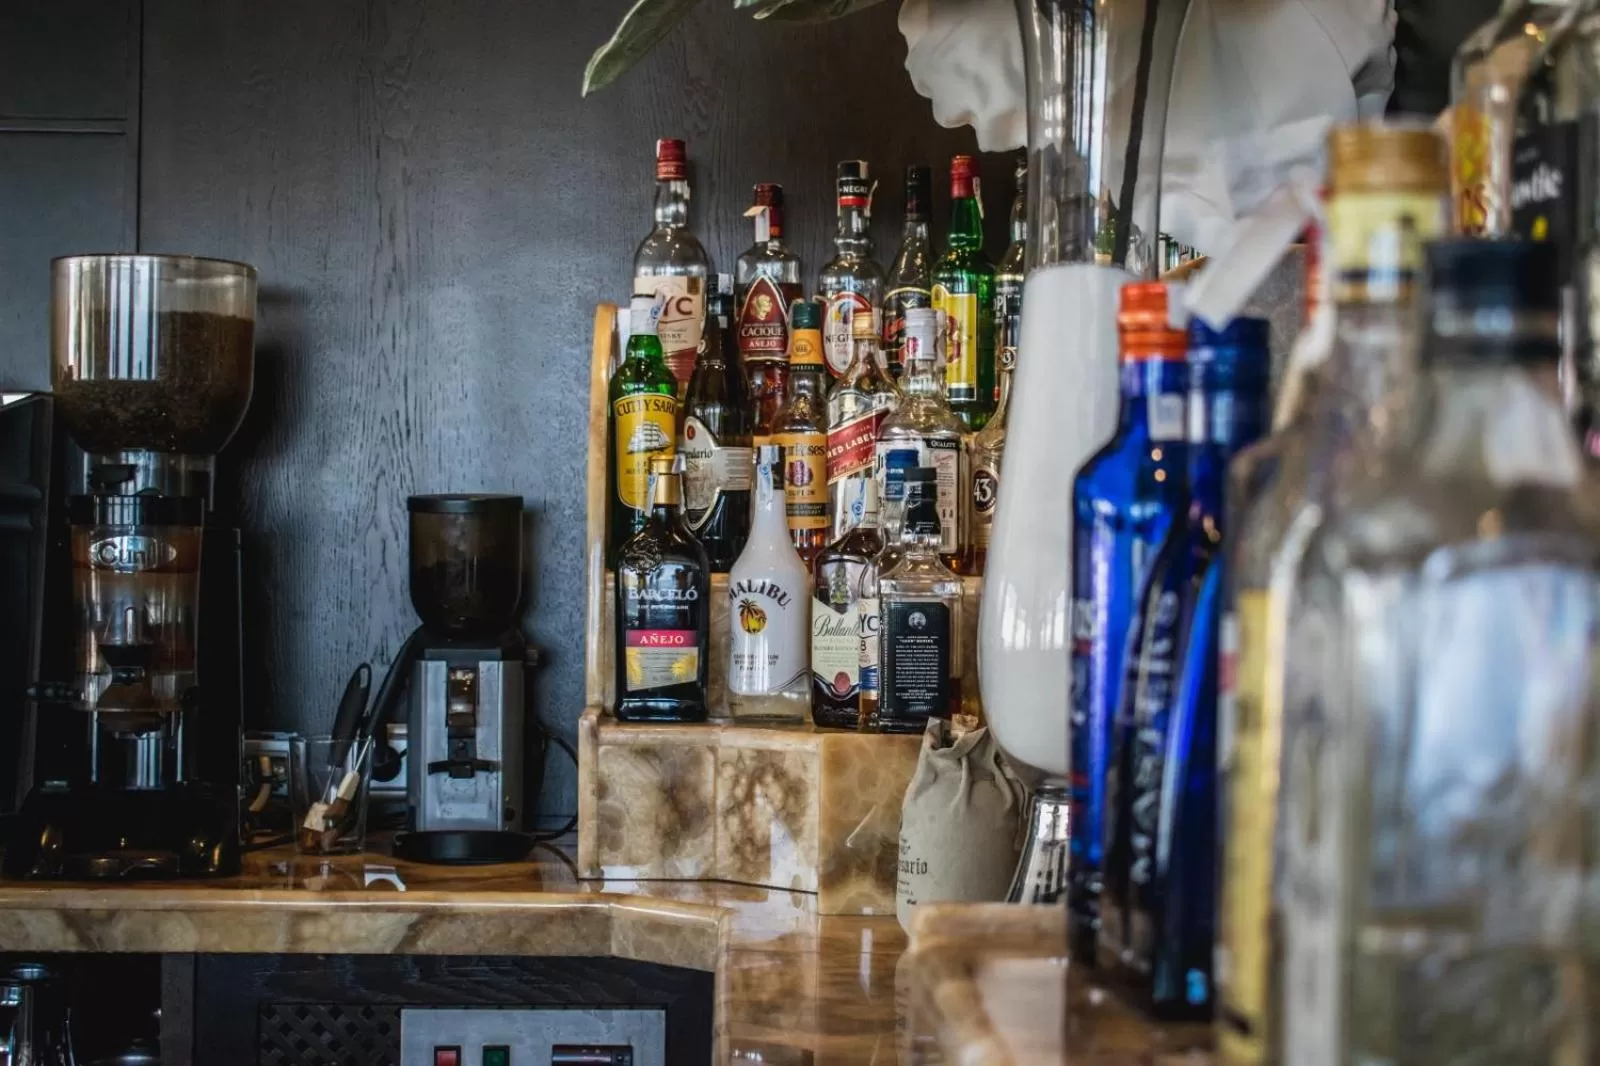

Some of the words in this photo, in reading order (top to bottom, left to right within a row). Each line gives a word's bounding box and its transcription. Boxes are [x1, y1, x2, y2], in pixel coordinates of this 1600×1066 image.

[741, 326, 784, 337] CACIQUE
[617, 399, 651, 416] CUTTY
[845, 431, 877, 450] LABEL
[974, 479, 992, 502] 43
[629, 586, 698, 601] BARCELÓ
[729, 579, 792, 609] MALIBU
[640, 633, 684, 644] AÑEJO
